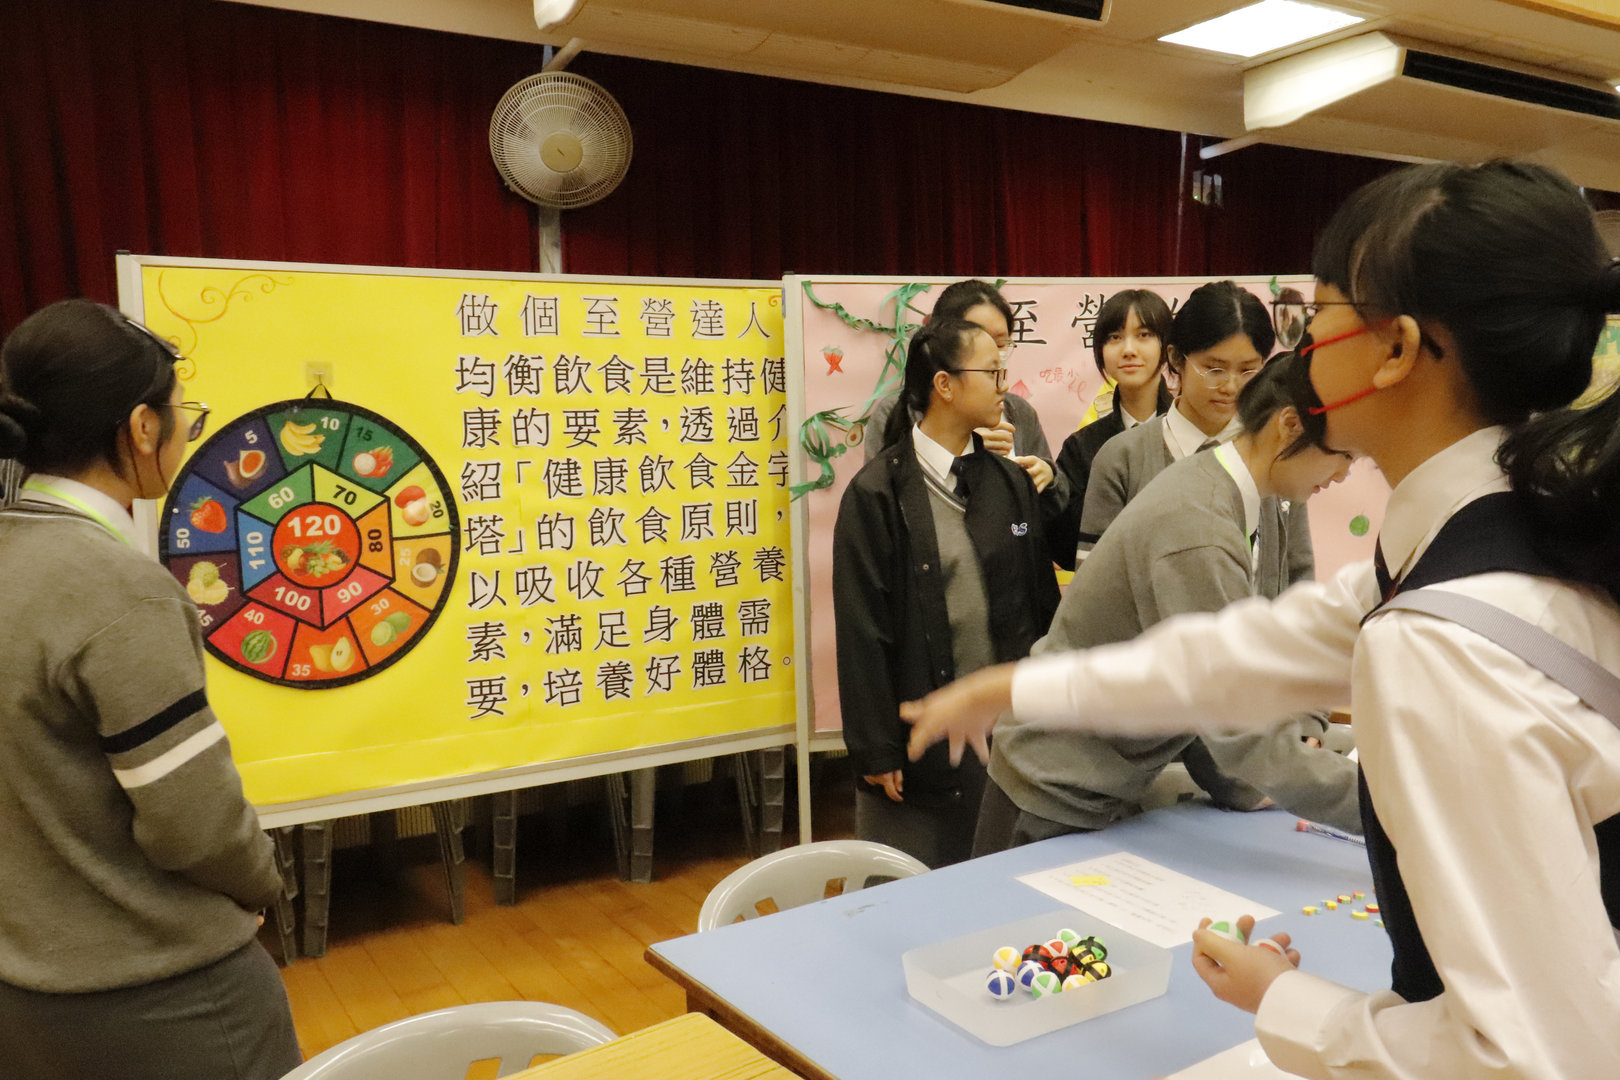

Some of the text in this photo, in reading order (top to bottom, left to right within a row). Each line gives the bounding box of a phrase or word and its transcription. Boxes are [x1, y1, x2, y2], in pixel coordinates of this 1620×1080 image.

[456, 294, 770, 339] 做個至營達人
[455, 355, 787, 398] 均衡飲食是維持健
[321, 417, 340, 431] 10
[356, 426, 374, 443] 15
[245, 430, 258, 445] 5
[268, 487, 296, 510] 60
[332, 484, 359, 507] 70
[430, 500, 445, 519] 20
[288, 514, 341, 537] 120
[177, 528, 191, 549] 50
[368, 528, 383, 554] 80
[247, 531, 264, 570] 110
[399, 547, 412, 567] 25
[469, 546, 787, 610] 以吸收各種營養
[273, 585, 311, 612] 100
[337, 580, 363, 602] 90
[243, 609, 265, 625] 40
[370, 597, 390, 615] 30
[291, 664, 312, 678] 35
